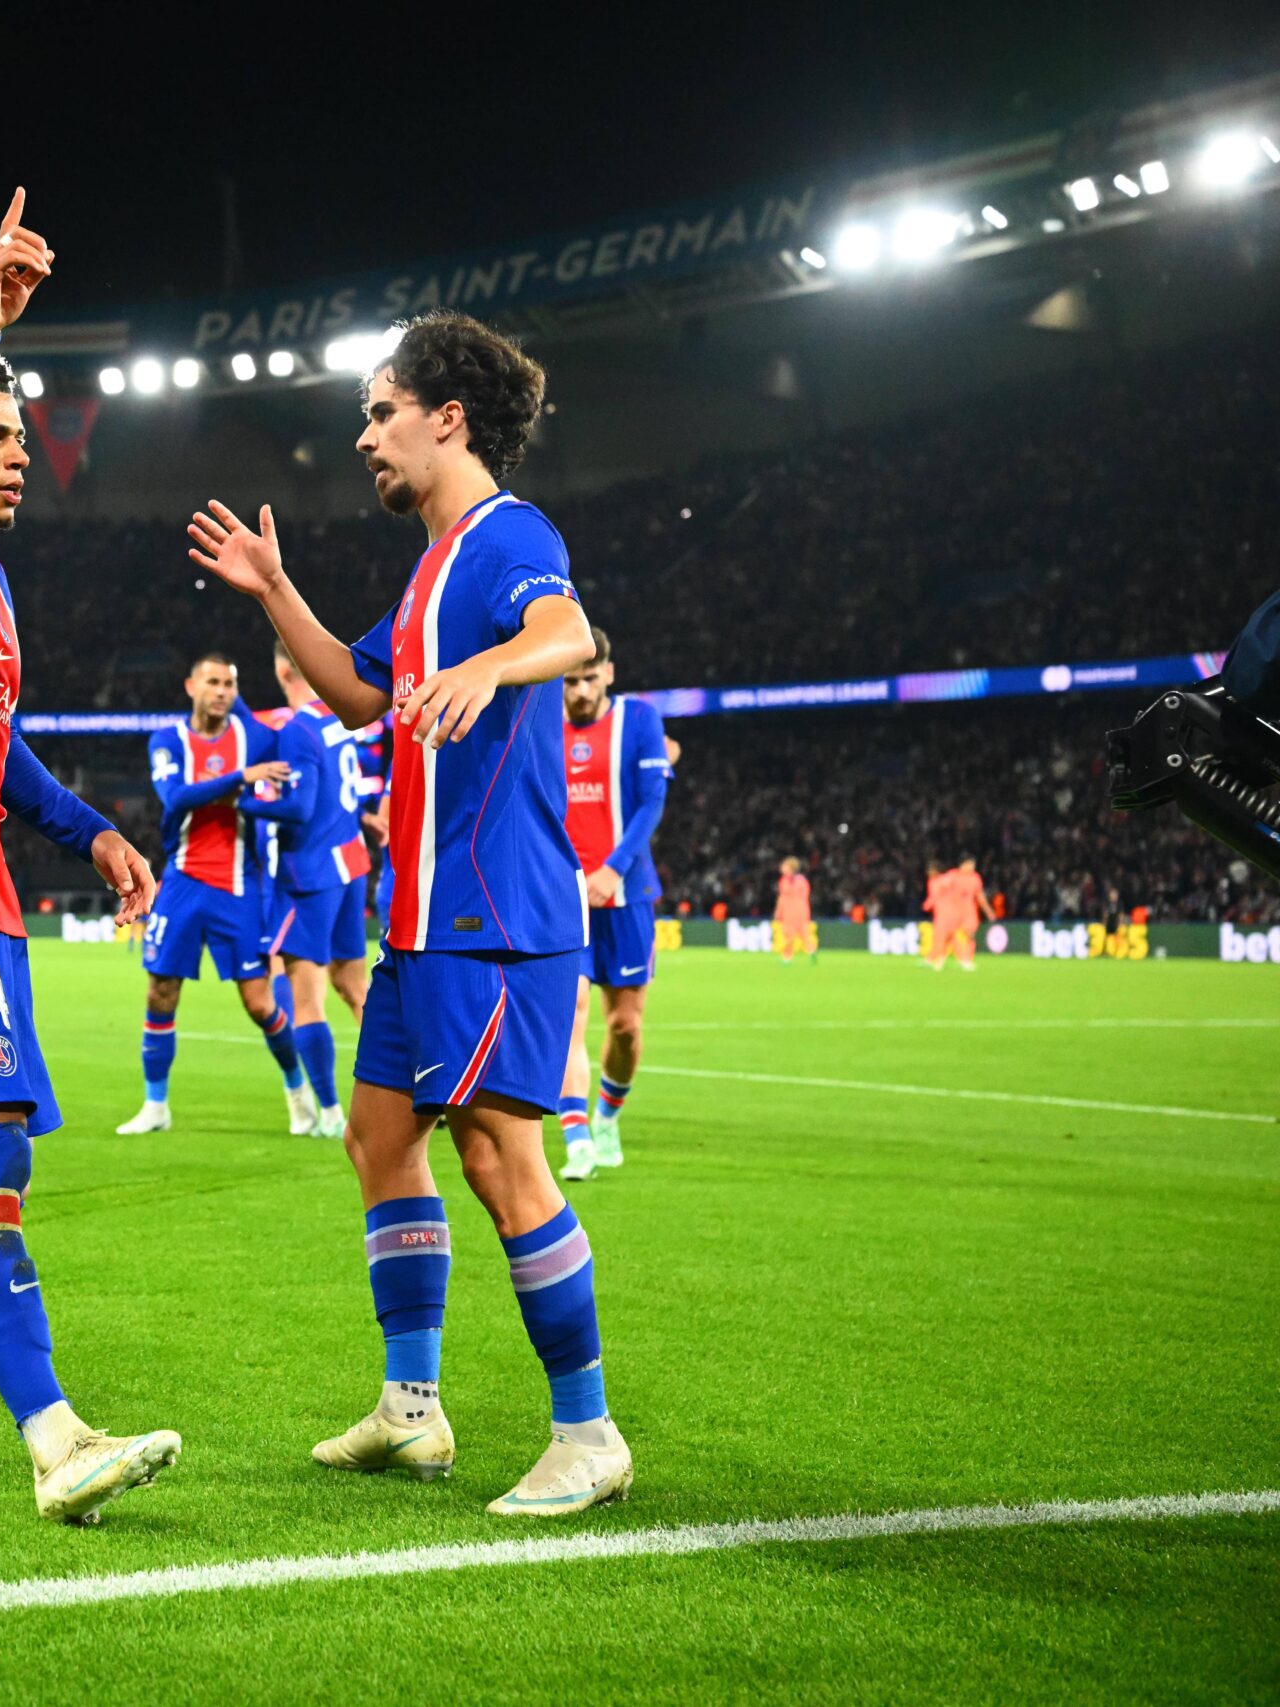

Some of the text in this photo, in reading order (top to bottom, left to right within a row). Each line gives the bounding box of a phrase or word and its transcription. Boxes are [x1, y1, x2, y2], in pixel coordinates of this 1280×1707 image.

[194, 187, 815, 347] PARIS SAINT-GERMAIN
[1219, 922, 1280, 963] bet
